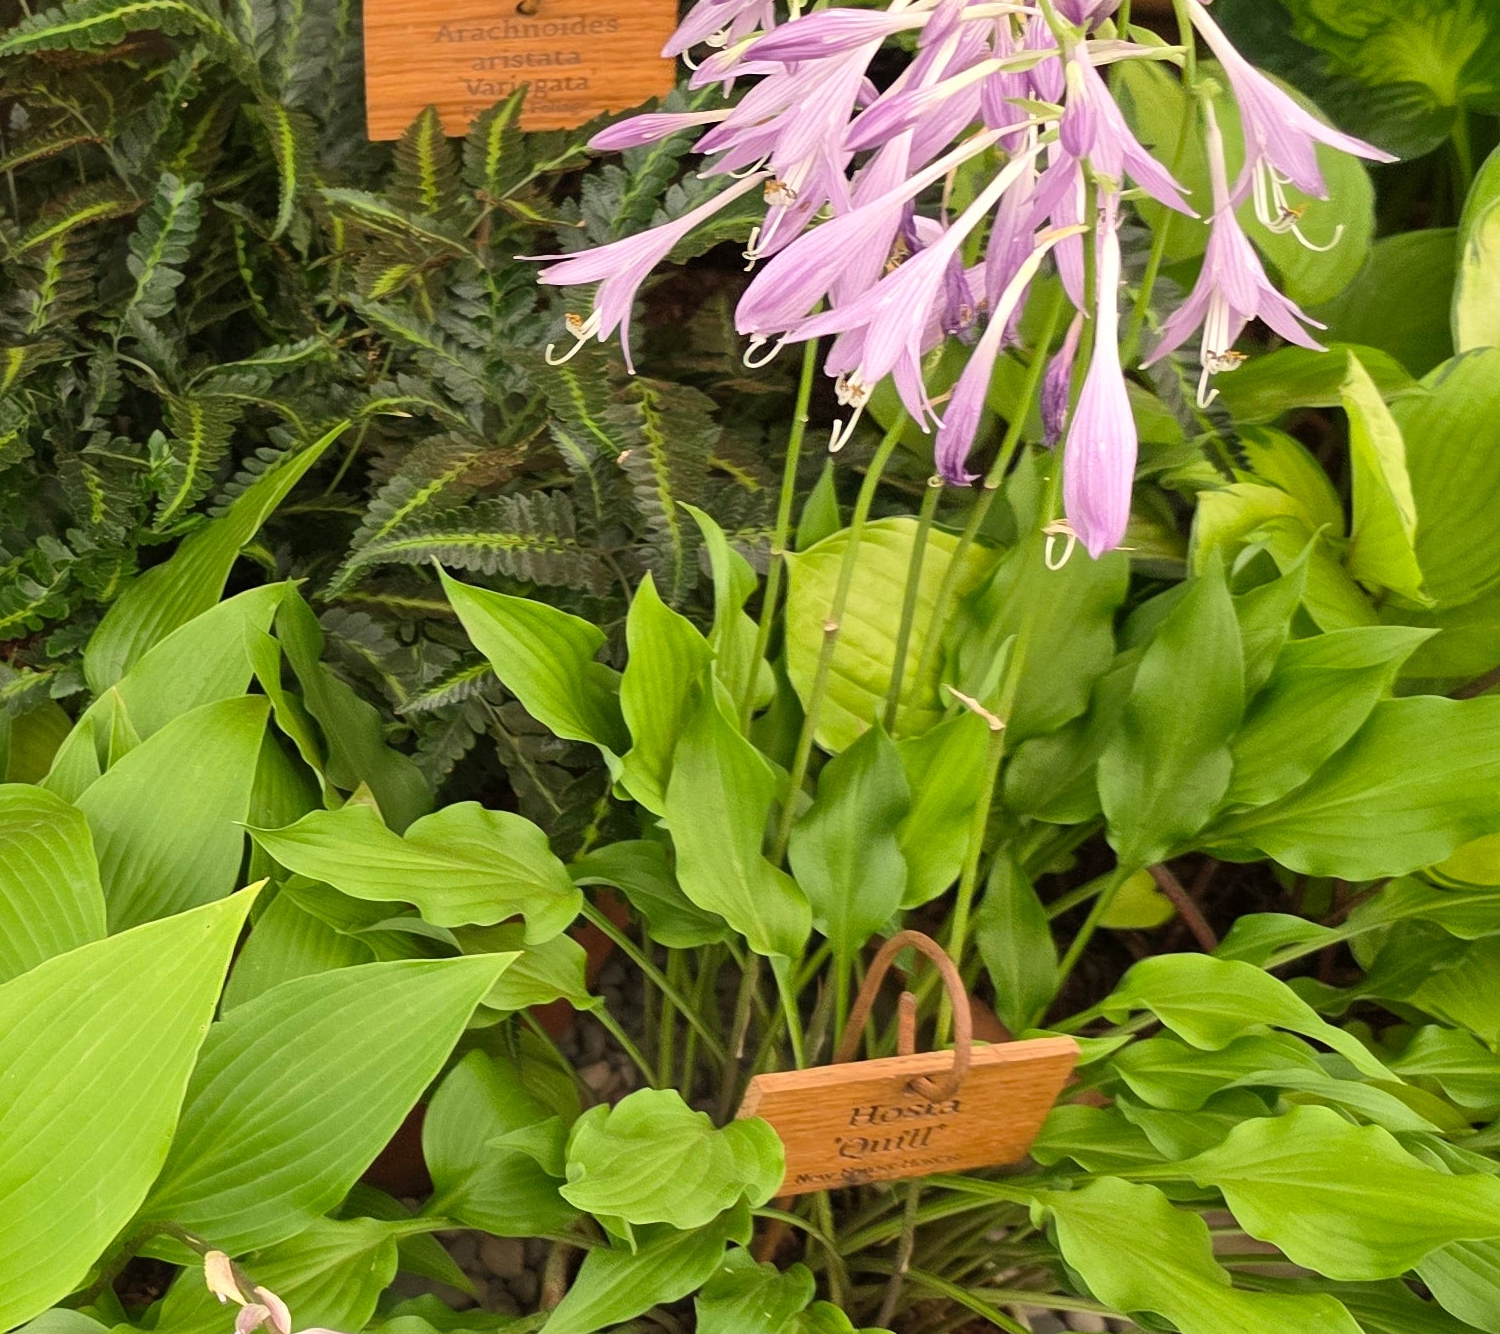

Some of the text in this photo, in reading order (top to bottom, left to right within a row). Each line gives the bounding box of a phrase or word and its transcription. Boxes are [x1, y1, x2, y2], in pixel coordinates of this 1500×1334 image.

[434, 17, 619, 43] Arachnoides
[471, 50, 582, 71] aristata
[849, 1099, 963, 1127] Hosta
